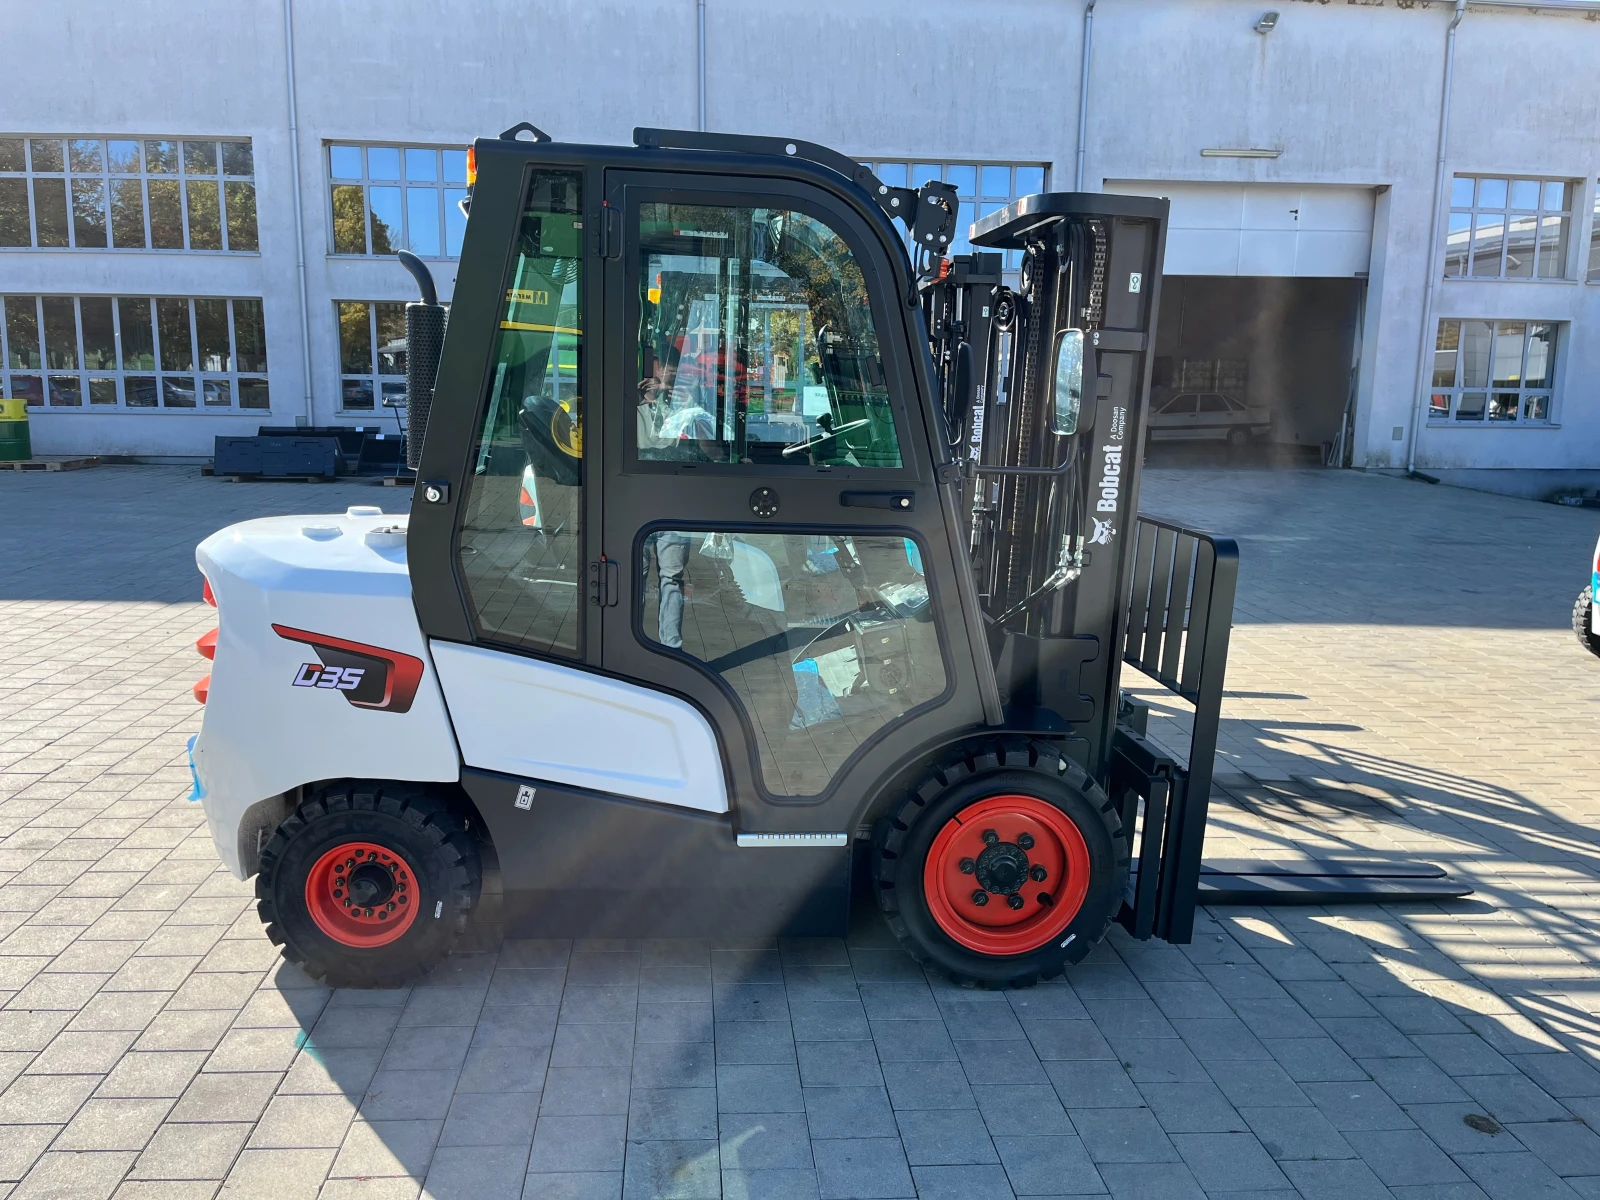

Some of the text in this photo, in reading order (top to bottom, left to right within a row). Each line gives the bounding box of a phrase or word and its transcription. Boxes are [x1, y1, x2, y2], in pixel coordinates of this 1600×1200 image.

[971, 405, 984, 442] Bobcat
[1111, 406, 1119, 432] Doosan
[1117, 407, 1126, 440] Company
[1097, 445, 1122, 511] Bobcat
[292, 662, 366, 690] D35
